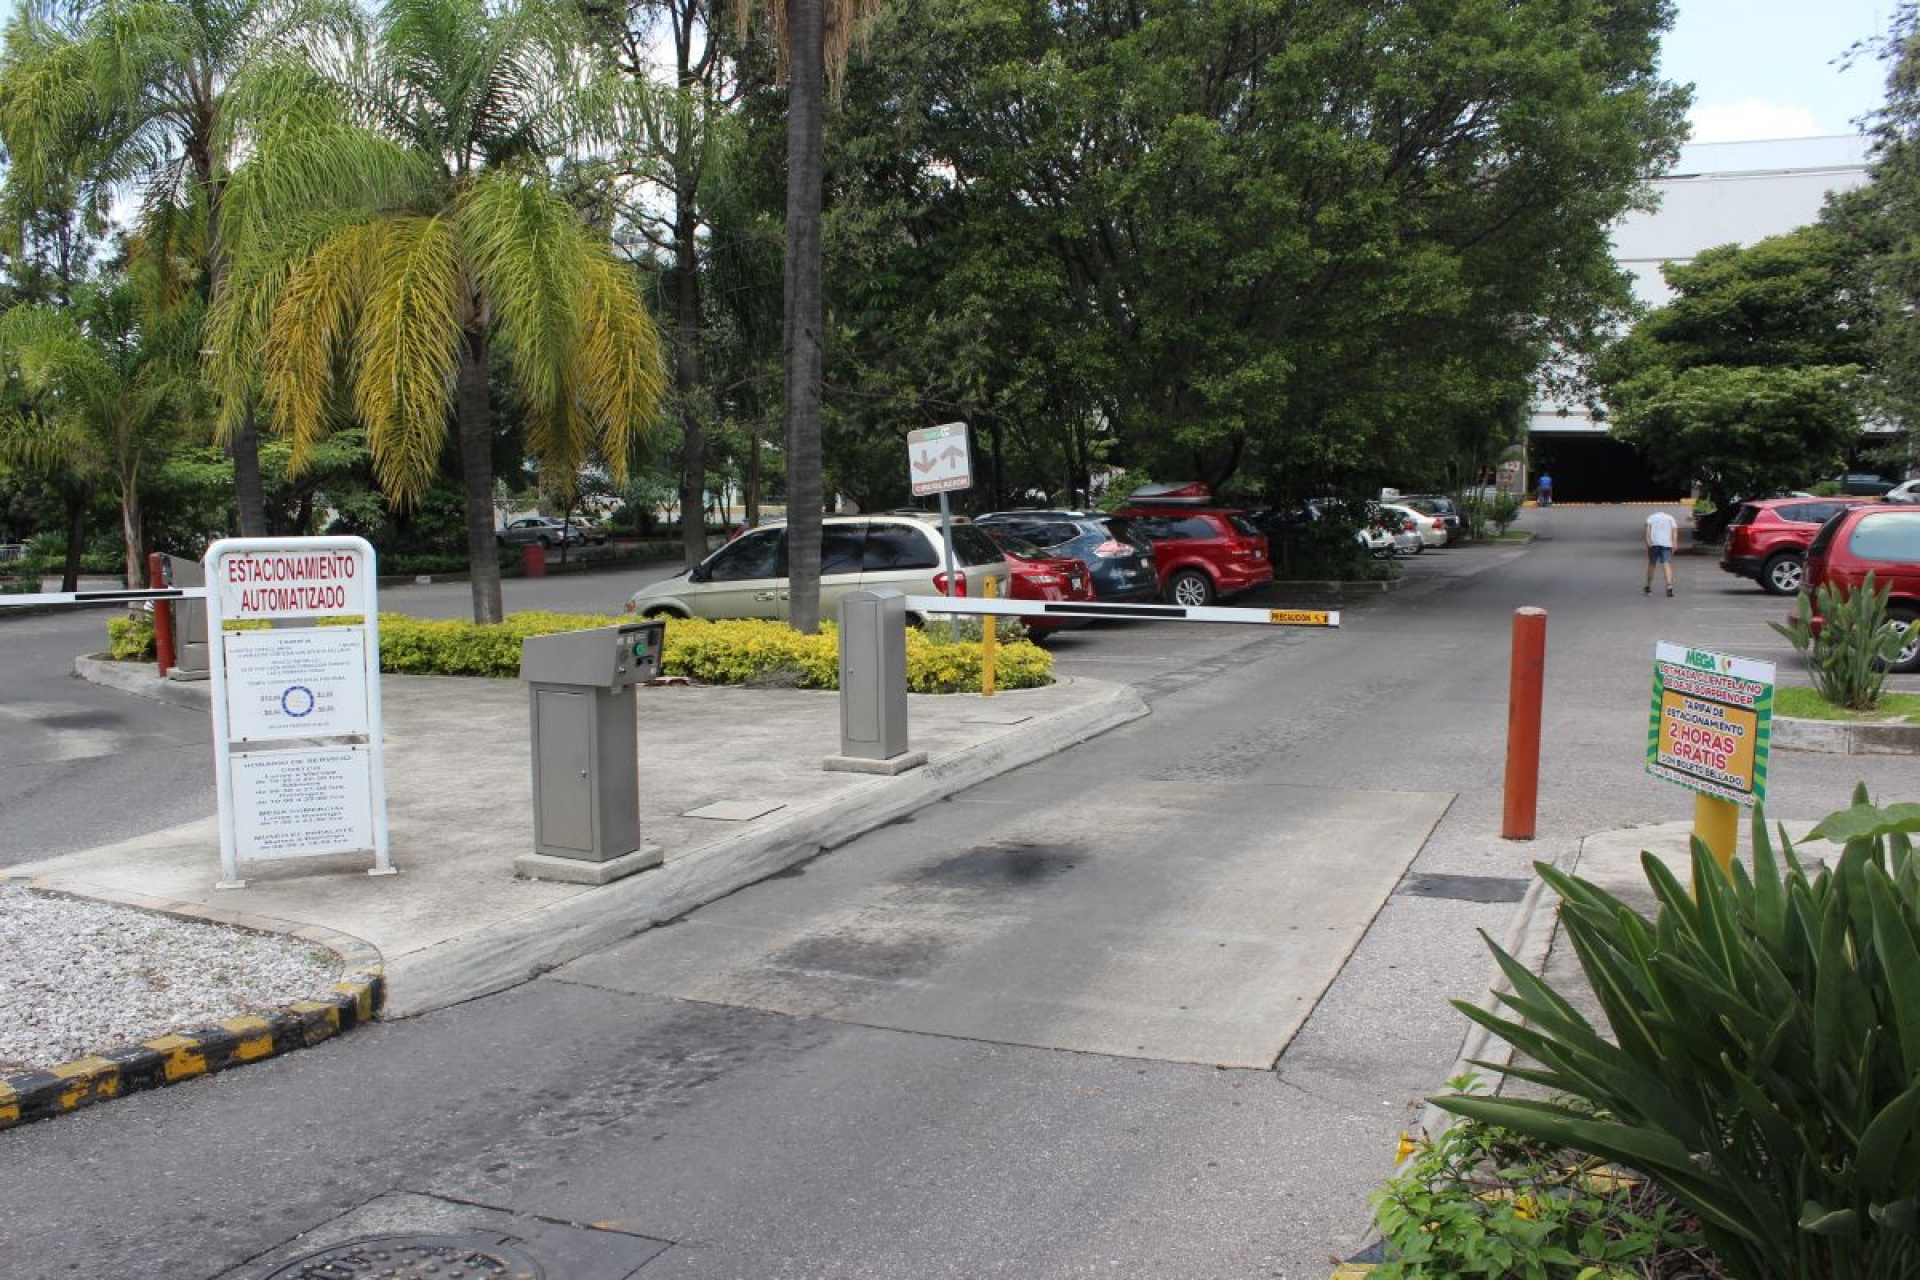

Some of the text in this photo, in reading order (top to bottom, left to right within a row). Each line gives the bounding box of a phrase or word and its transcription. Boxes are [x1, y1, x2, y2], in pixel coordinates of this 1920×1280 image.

[229, 556, 355, 583] ESTACIONAMIENTO
[242, 585, 345, 612] AUTOMATIZADO
[1685, 648, 1715, 671] MEGA
[1747, 684, 1762, 695] NO
[1667, 708, 1743, 736] ESTACIONAMIENTO
[1685, 699, 1724, 718] TARIFA DE
[1670, 722, 1734, 754] 2 HORAS
[1673, 741, 1726, 769] GRATIS
